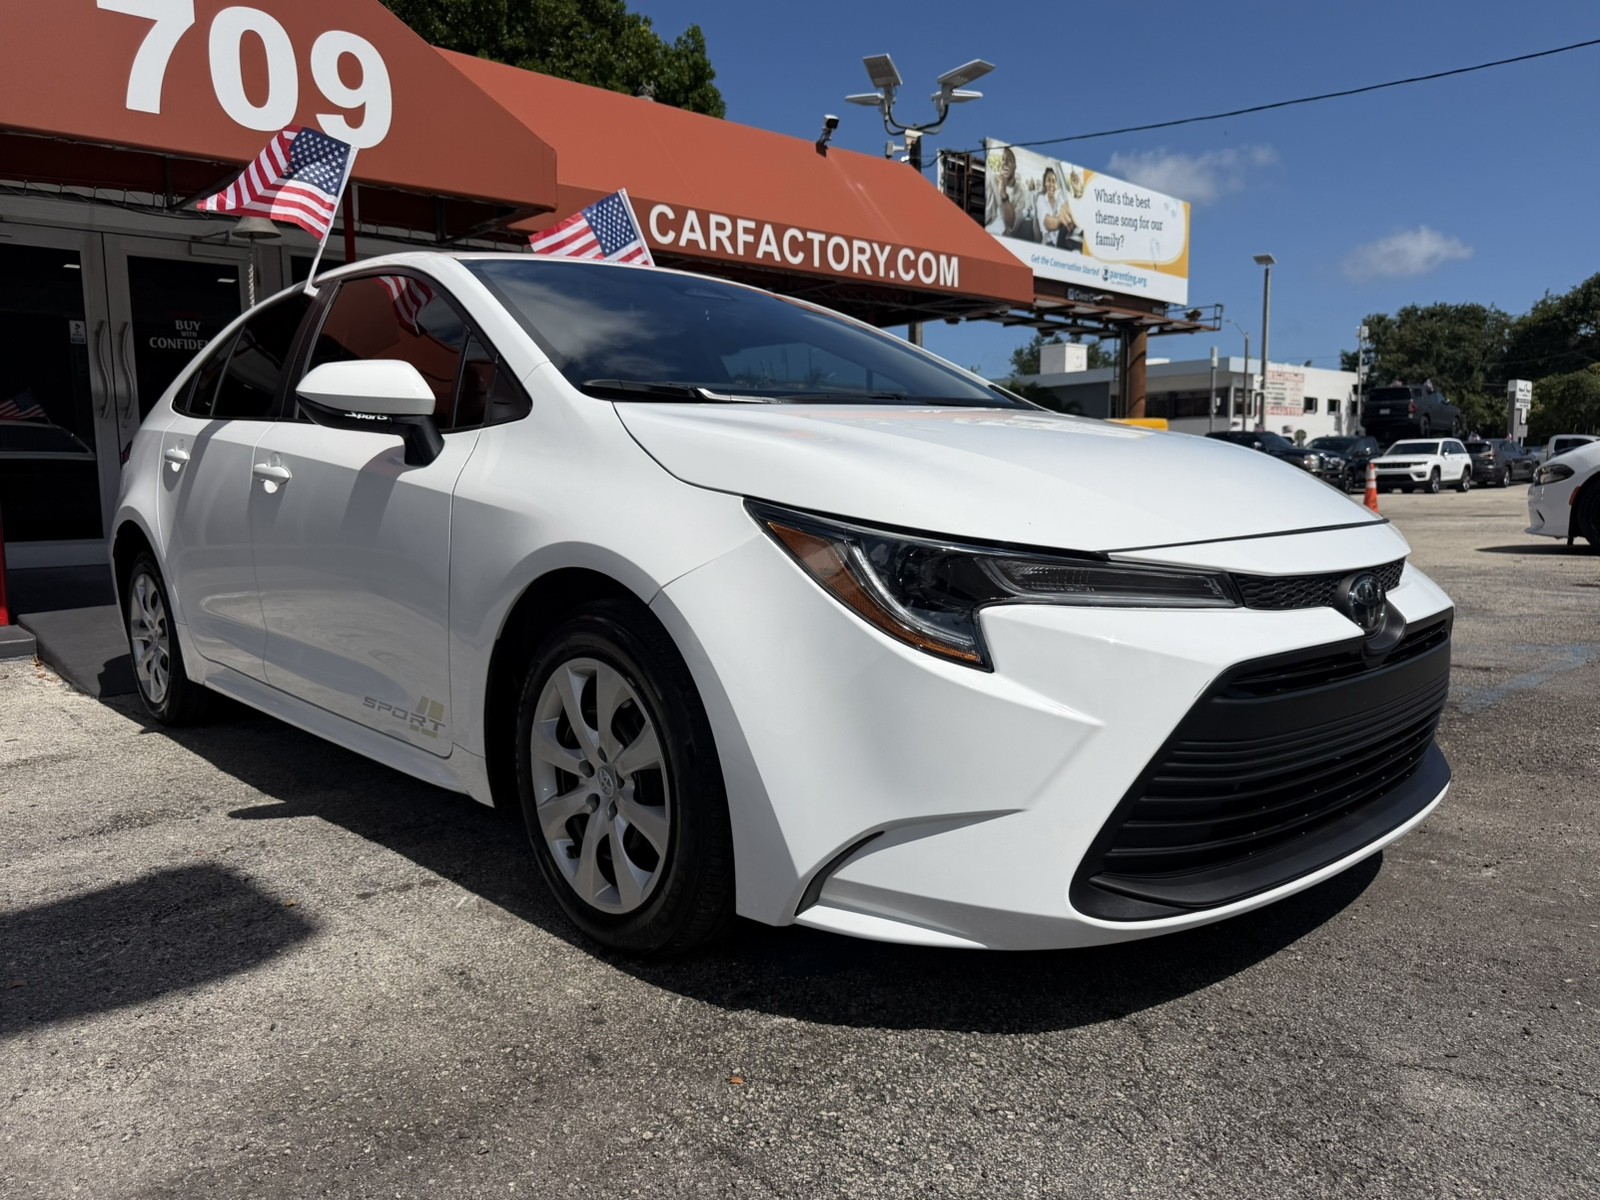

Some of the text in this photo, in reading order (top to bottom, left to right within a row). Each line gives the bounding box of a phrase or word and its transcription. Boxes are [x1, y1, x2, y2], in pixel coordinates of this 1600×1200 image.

[96, 0, 393, 149] 709
[1094, 188, 1151, 209] What's the best
[1095, 210, 1163, 232] theme song for our
[649, 204, 959, 288] CARFACTORY.COM
[1095, 231, 1125, 251] family?
[175, 320, 201, 331] BUY
[362, 696, 446, 732] SPORT
